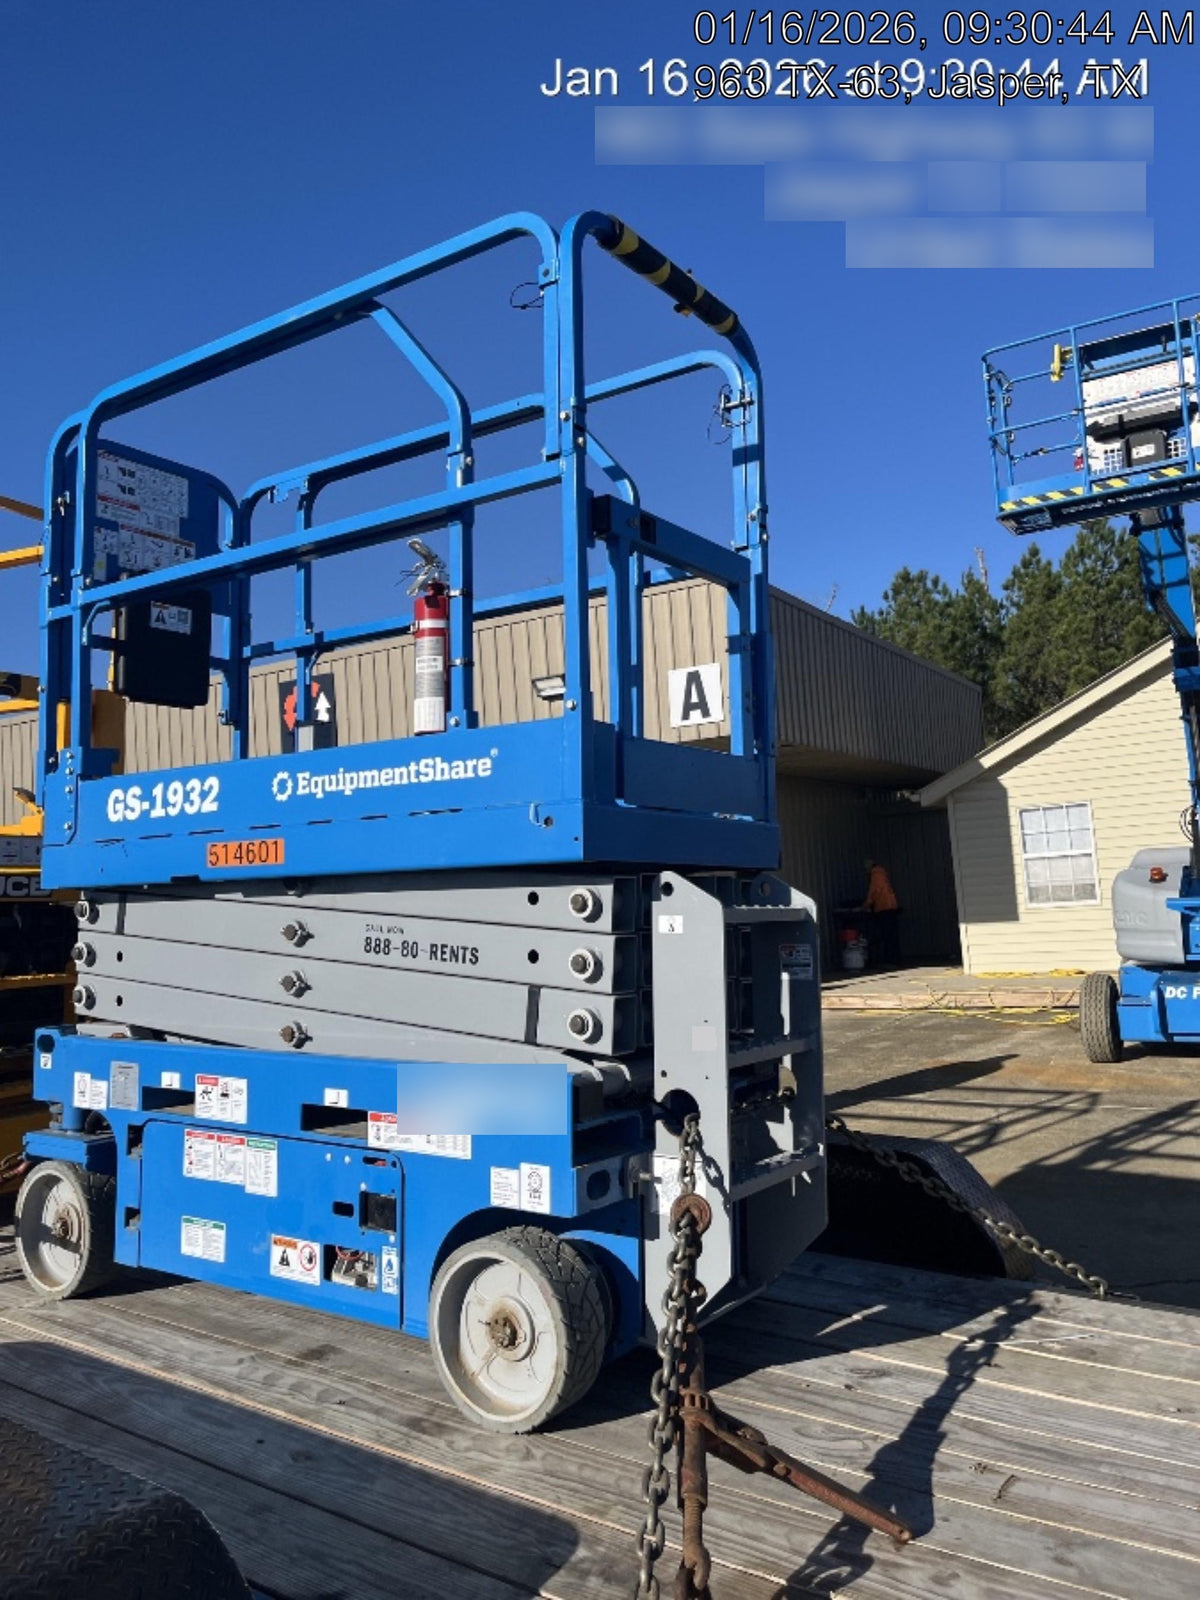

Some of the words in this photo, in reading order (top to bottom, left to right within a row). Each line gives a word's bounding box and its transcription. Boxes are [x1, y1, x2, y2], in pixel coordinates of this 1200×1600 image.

[681, 669, 711, 721] A
[107, 776, 220, 823] GS-1932
[208, 839, 281, 867] 514601
[364, 936, 479, 966] 888-80-RENTS
[1165, 986, 1188, 999] DC
